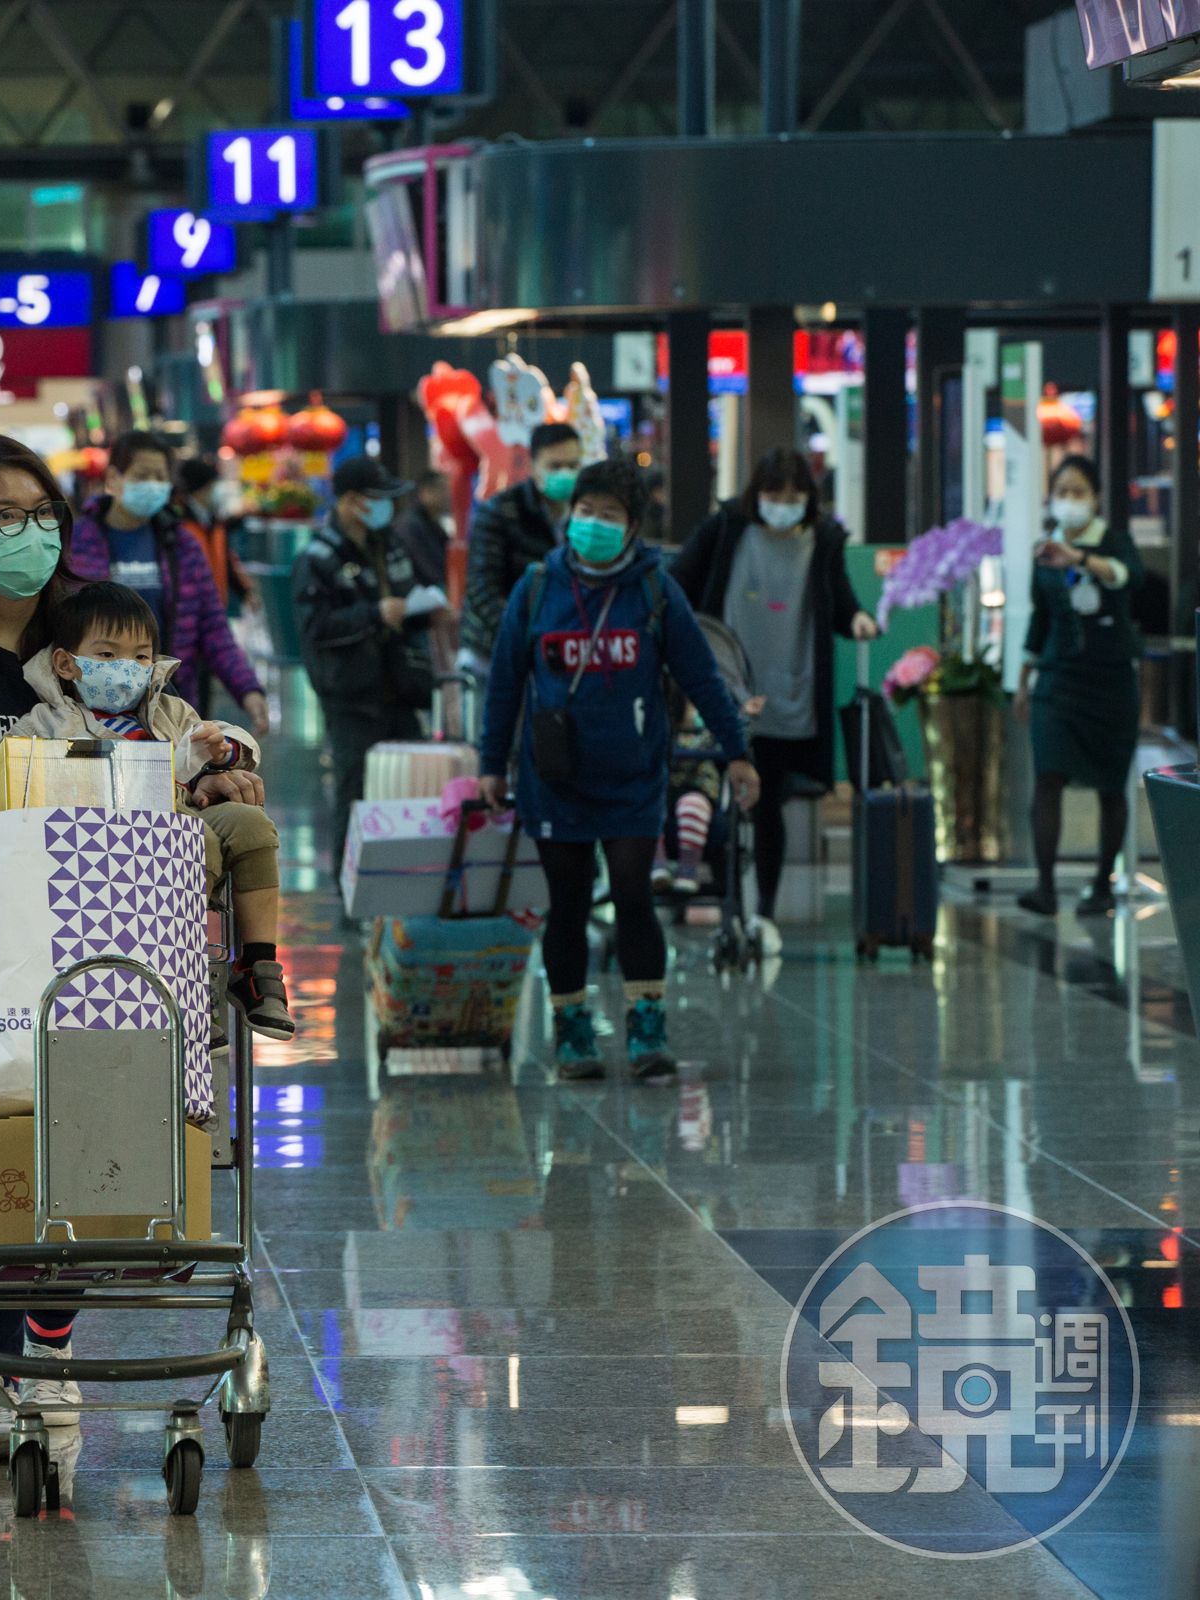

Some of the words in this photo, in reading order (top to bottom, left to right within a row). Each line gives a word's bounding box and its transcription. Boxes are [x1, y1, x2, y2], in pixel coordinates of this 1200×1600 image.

[335, 0, 447, 86] 13
[222, 134, 297, 205] 11
[172, 211, 212, 269] 9
